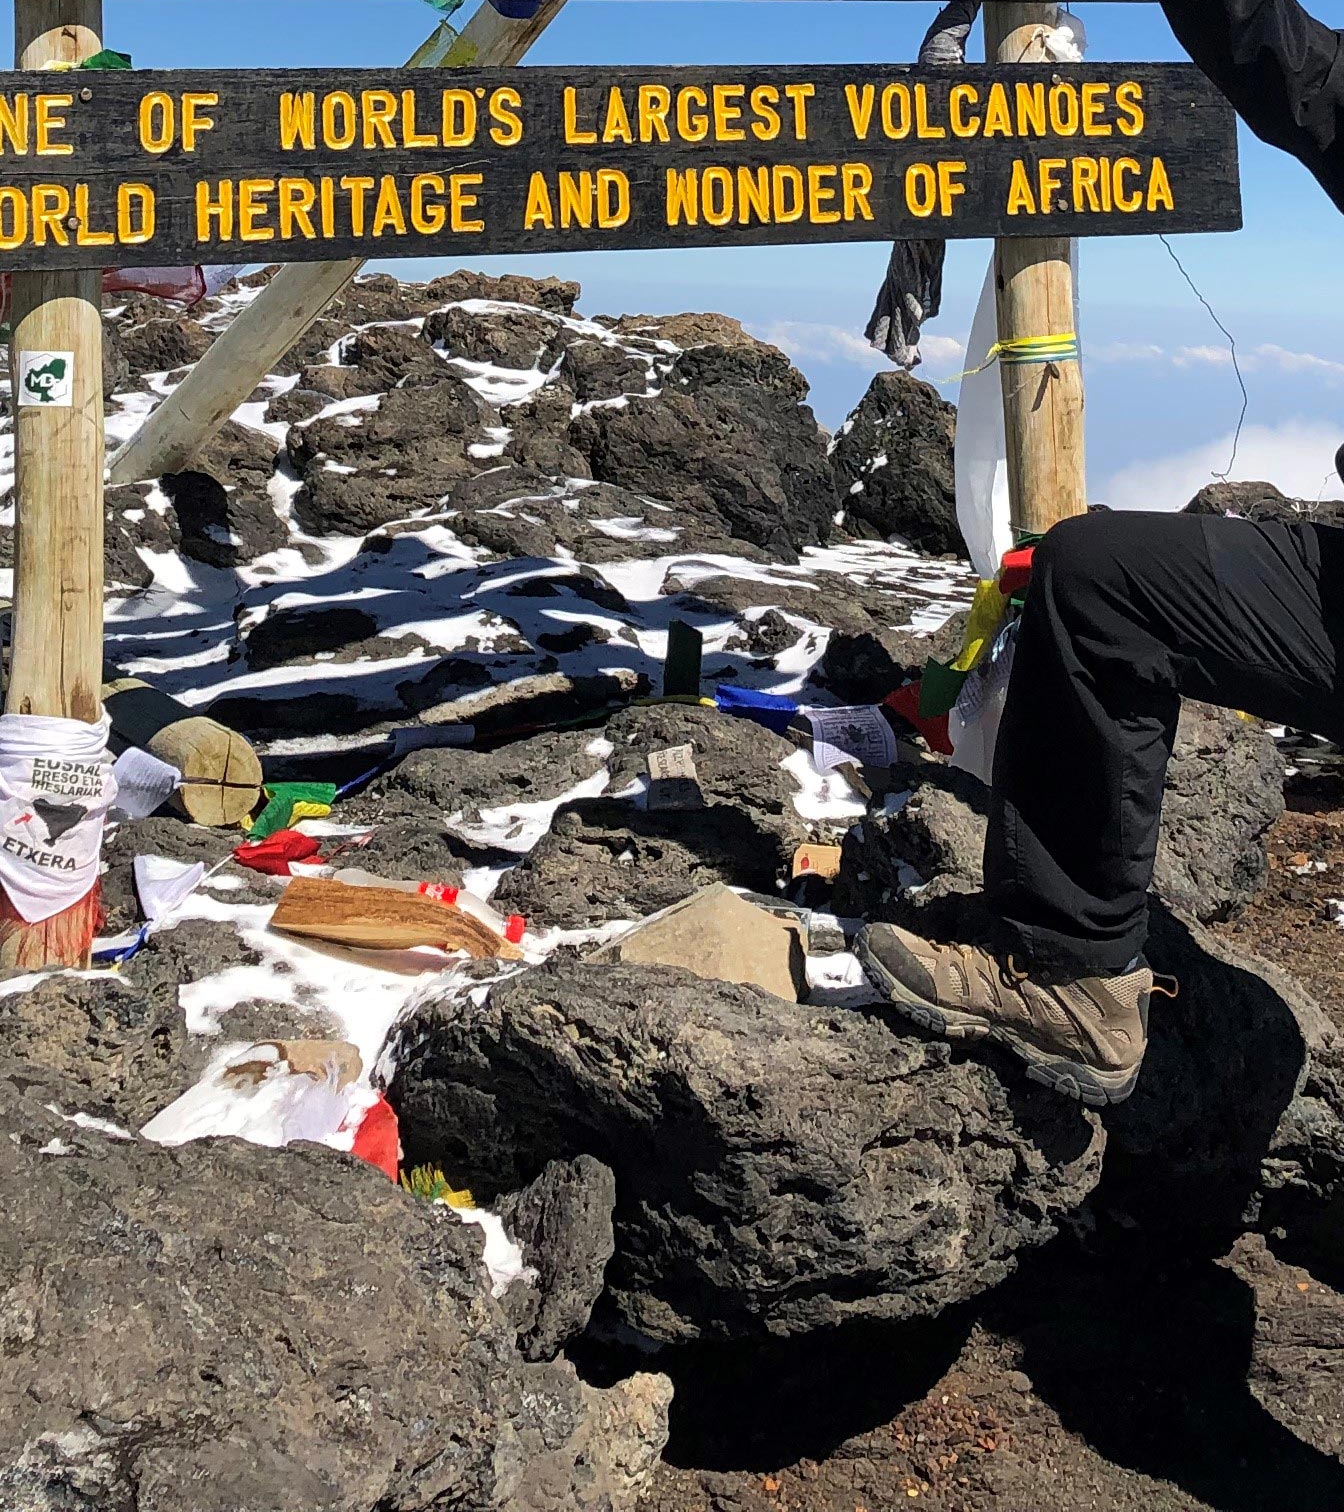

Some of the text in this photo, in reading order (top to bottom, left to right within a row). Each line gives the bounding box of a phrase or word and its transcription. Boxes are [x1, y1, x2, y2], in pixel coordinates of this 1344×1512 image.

[139, 92, 217, 150] OF
[280, 88, 522, 148] WORLD'S
[564, 84, 814, 143] LARGEST
[845, 81, 1144, 139] VOLCANOES
[195, 173, 483, 239] HERITAGE
[525, 169, 630, 229] AND
[667, 163, 873, 226] WONDER
[906, 161, 966, 217] OF
[1007, 157, 1173, 214] AFRICA
[32, 769, 79, 785] PRESO
[2, 836, 77, 872] ETXERA
